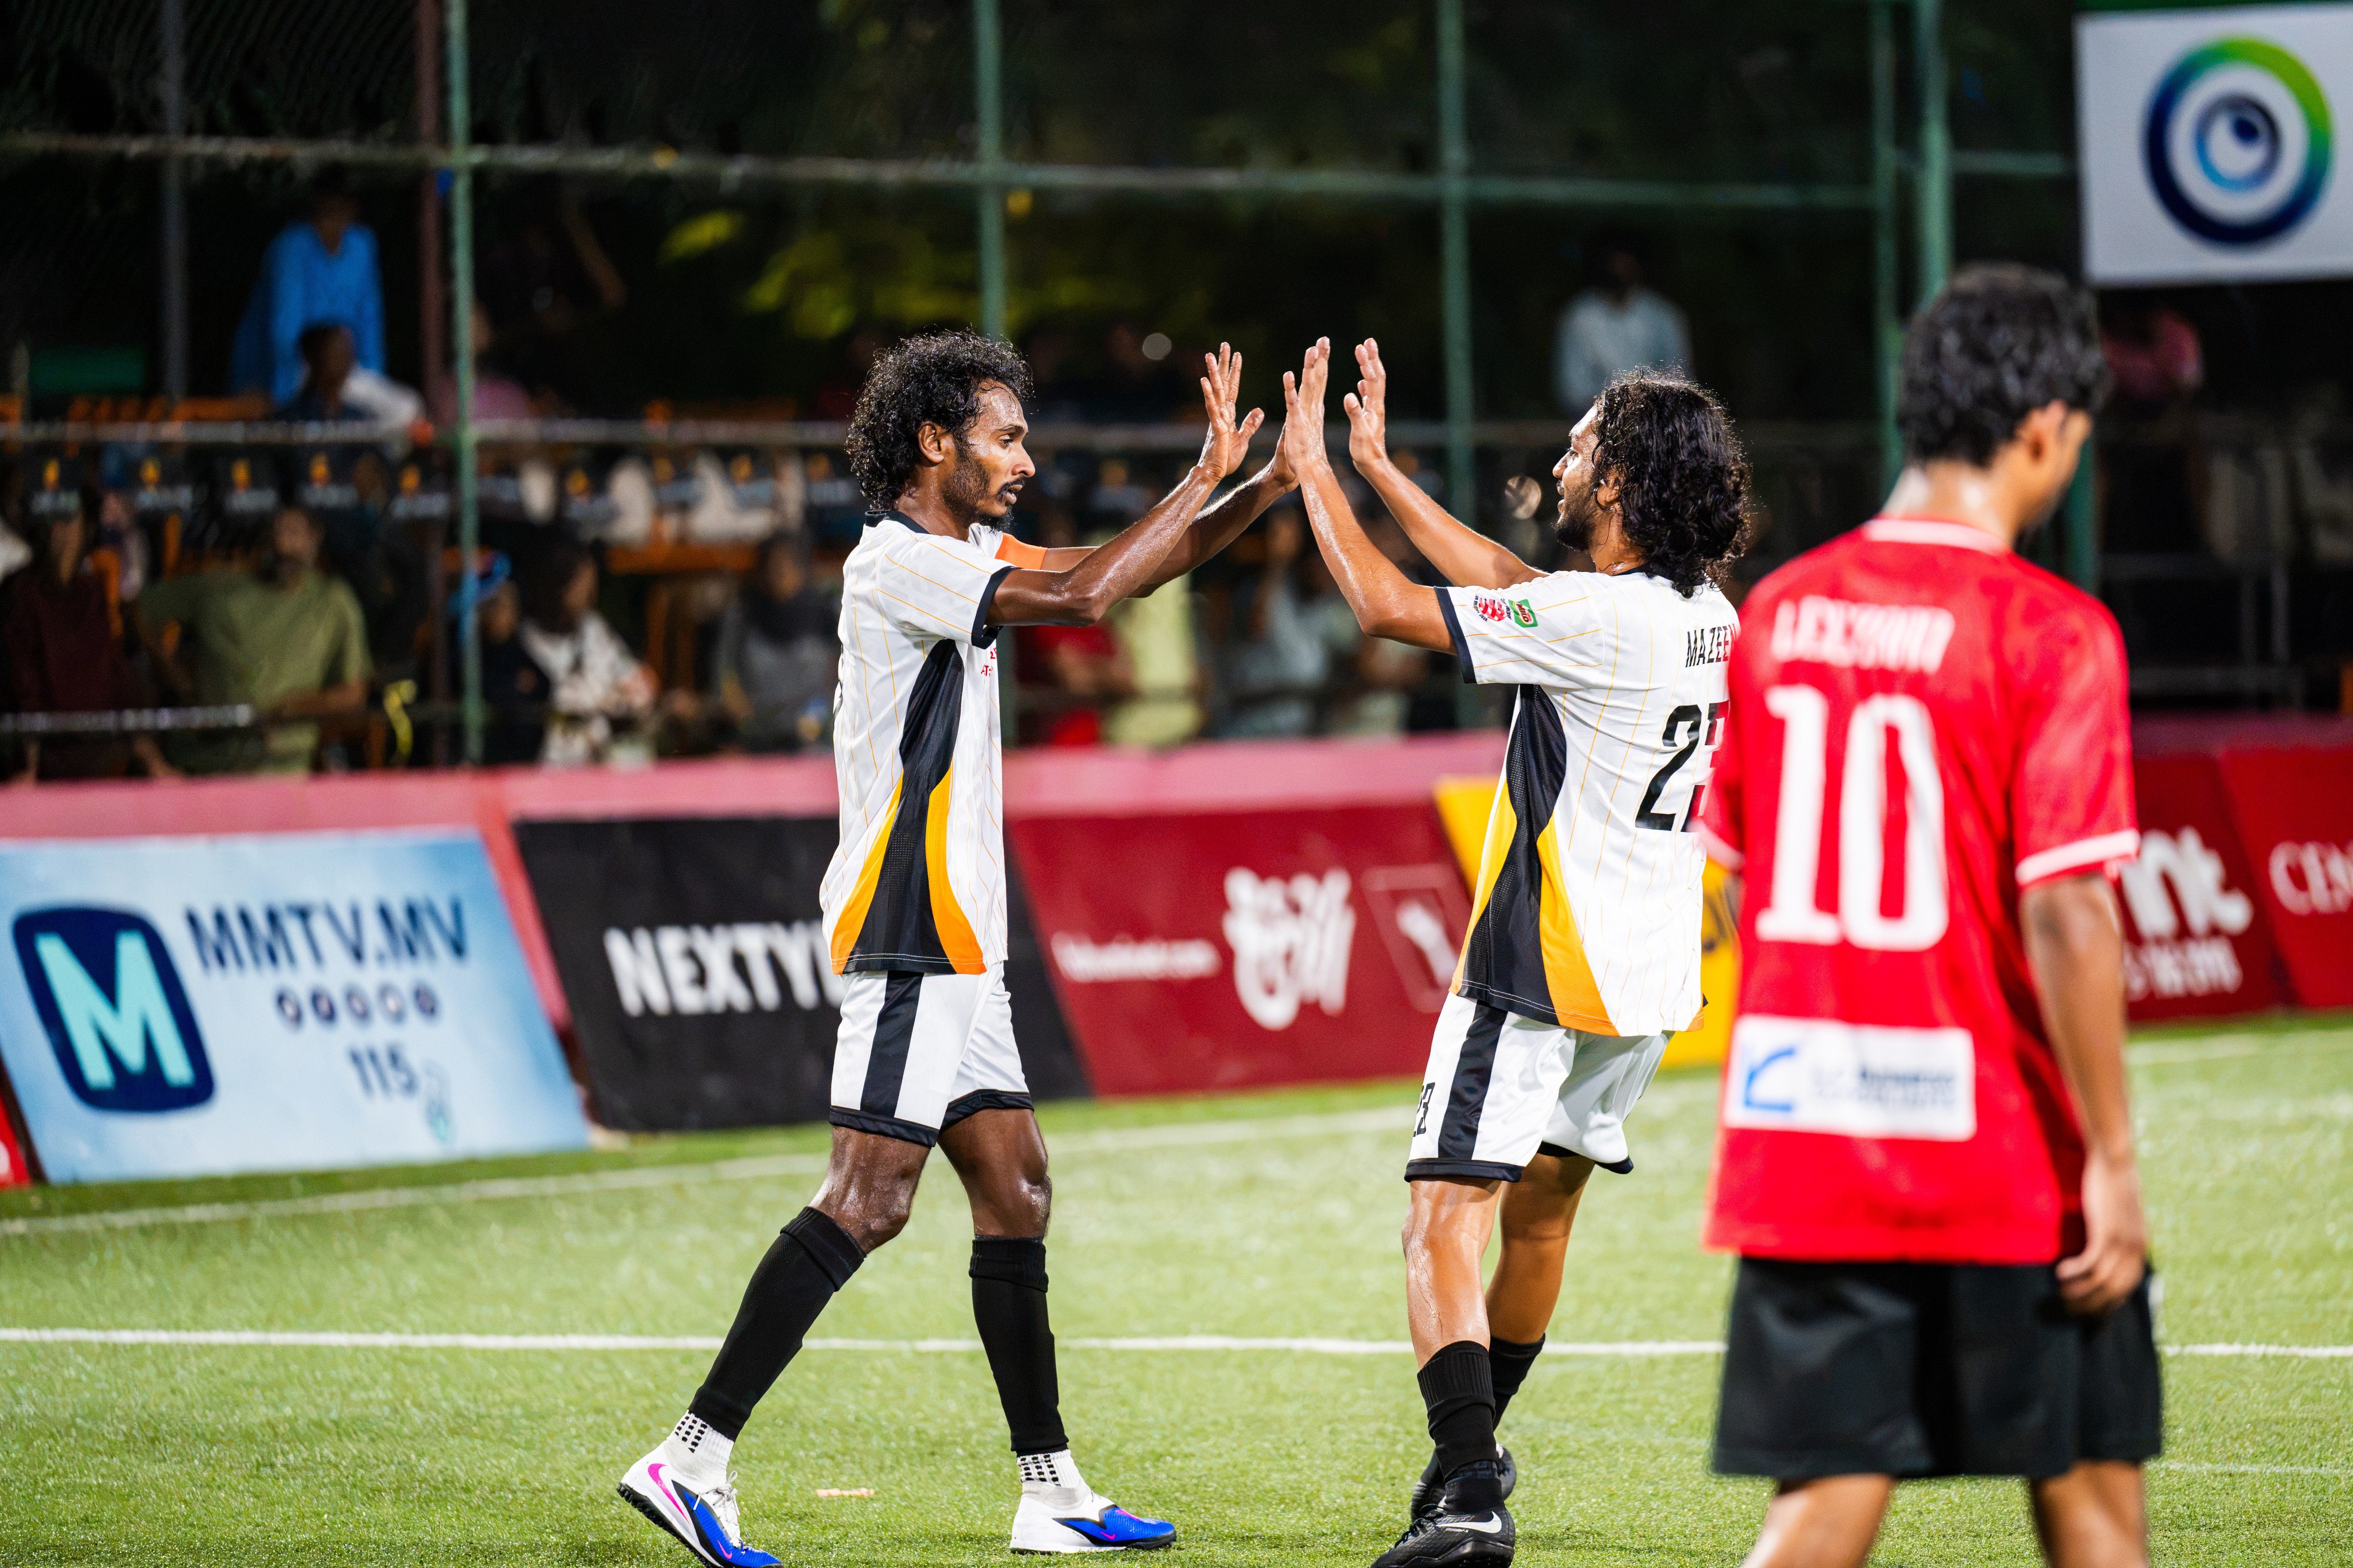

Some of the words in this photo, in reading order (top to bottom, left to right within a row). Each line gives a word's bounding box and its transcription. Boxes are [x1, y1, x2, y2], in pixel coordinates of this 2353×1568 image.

[1516, 603, 1529, 622] MILO
[1756, 685, 1948, 950] 10
[185, 895, 468, 976] MMTV.MV
[348, 1043, 417, 1099] 115
